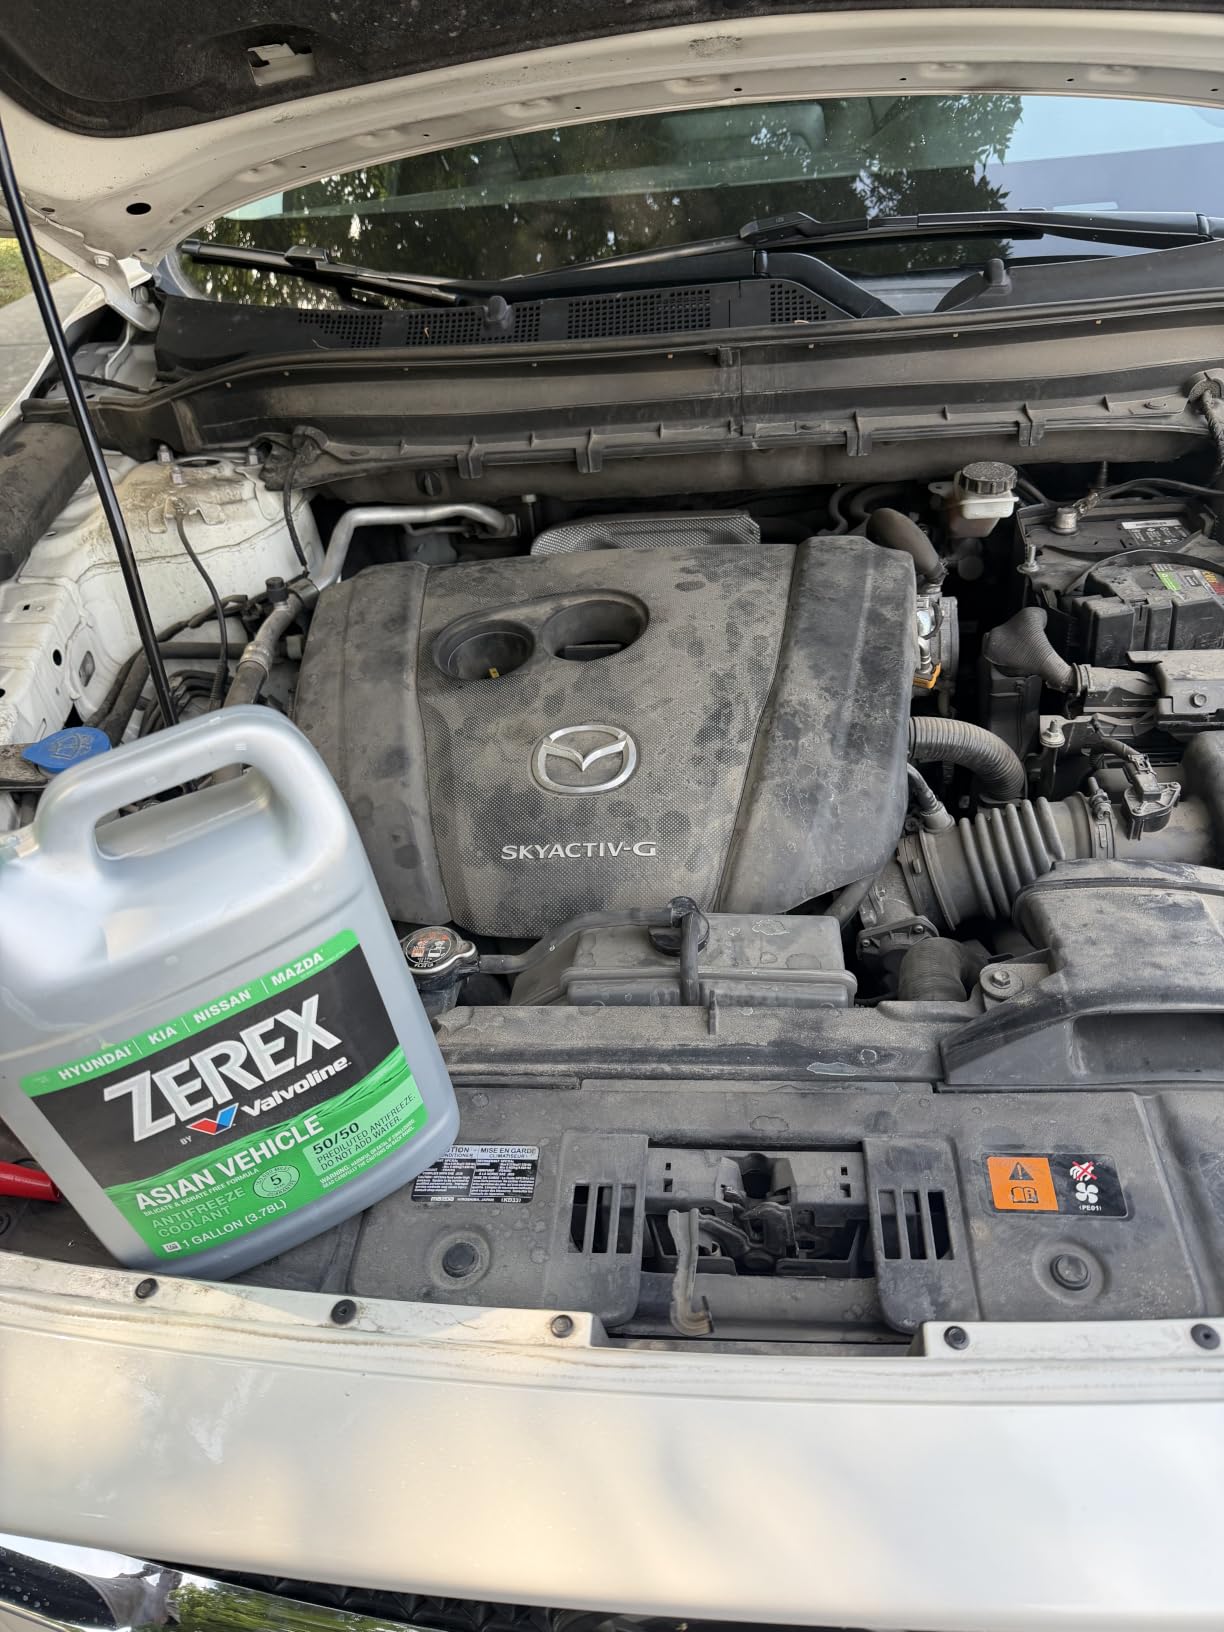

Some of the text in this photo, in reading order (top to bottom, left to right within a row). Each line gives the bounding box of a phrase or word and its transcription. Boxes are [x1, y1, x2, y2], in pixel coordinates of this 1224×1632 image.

[501, 841, 657, 860] SKYACTIV-G
[58, 1045, 132, 1080] HYUNDAI
[147, 1026, 177, 1045] KIA
[193, 989, 252, 1024] NISSAN
[271, 952, 324, 986] MAZDA
[103, 993, 343, 1143] ZEREX
[241, 1055, 350, 1117] Valvoline
[180, 1135, 193, 1145] BY
[312, 1122, 360, 1155] 50/50
[316, 1130, 369, 1163] PREDILUTED
[320, 1160, 335, 1171] DO
[335, 1150, 354, 1163] NOT
[355, 1137, 373, 1151] ADD
[135, 1115, 324, 1210] ASIAN VEHICLE
[227, 1168, 260, 1186] FORMULA
[270, 1174, 282, 1186] 5
[152, 1186, 246, 1229] ANTIFREEZE
[158, 1205, 232, 1238] COOLANT
[182, 1199, 287, 1249] 1 GALLON (3.78L)
